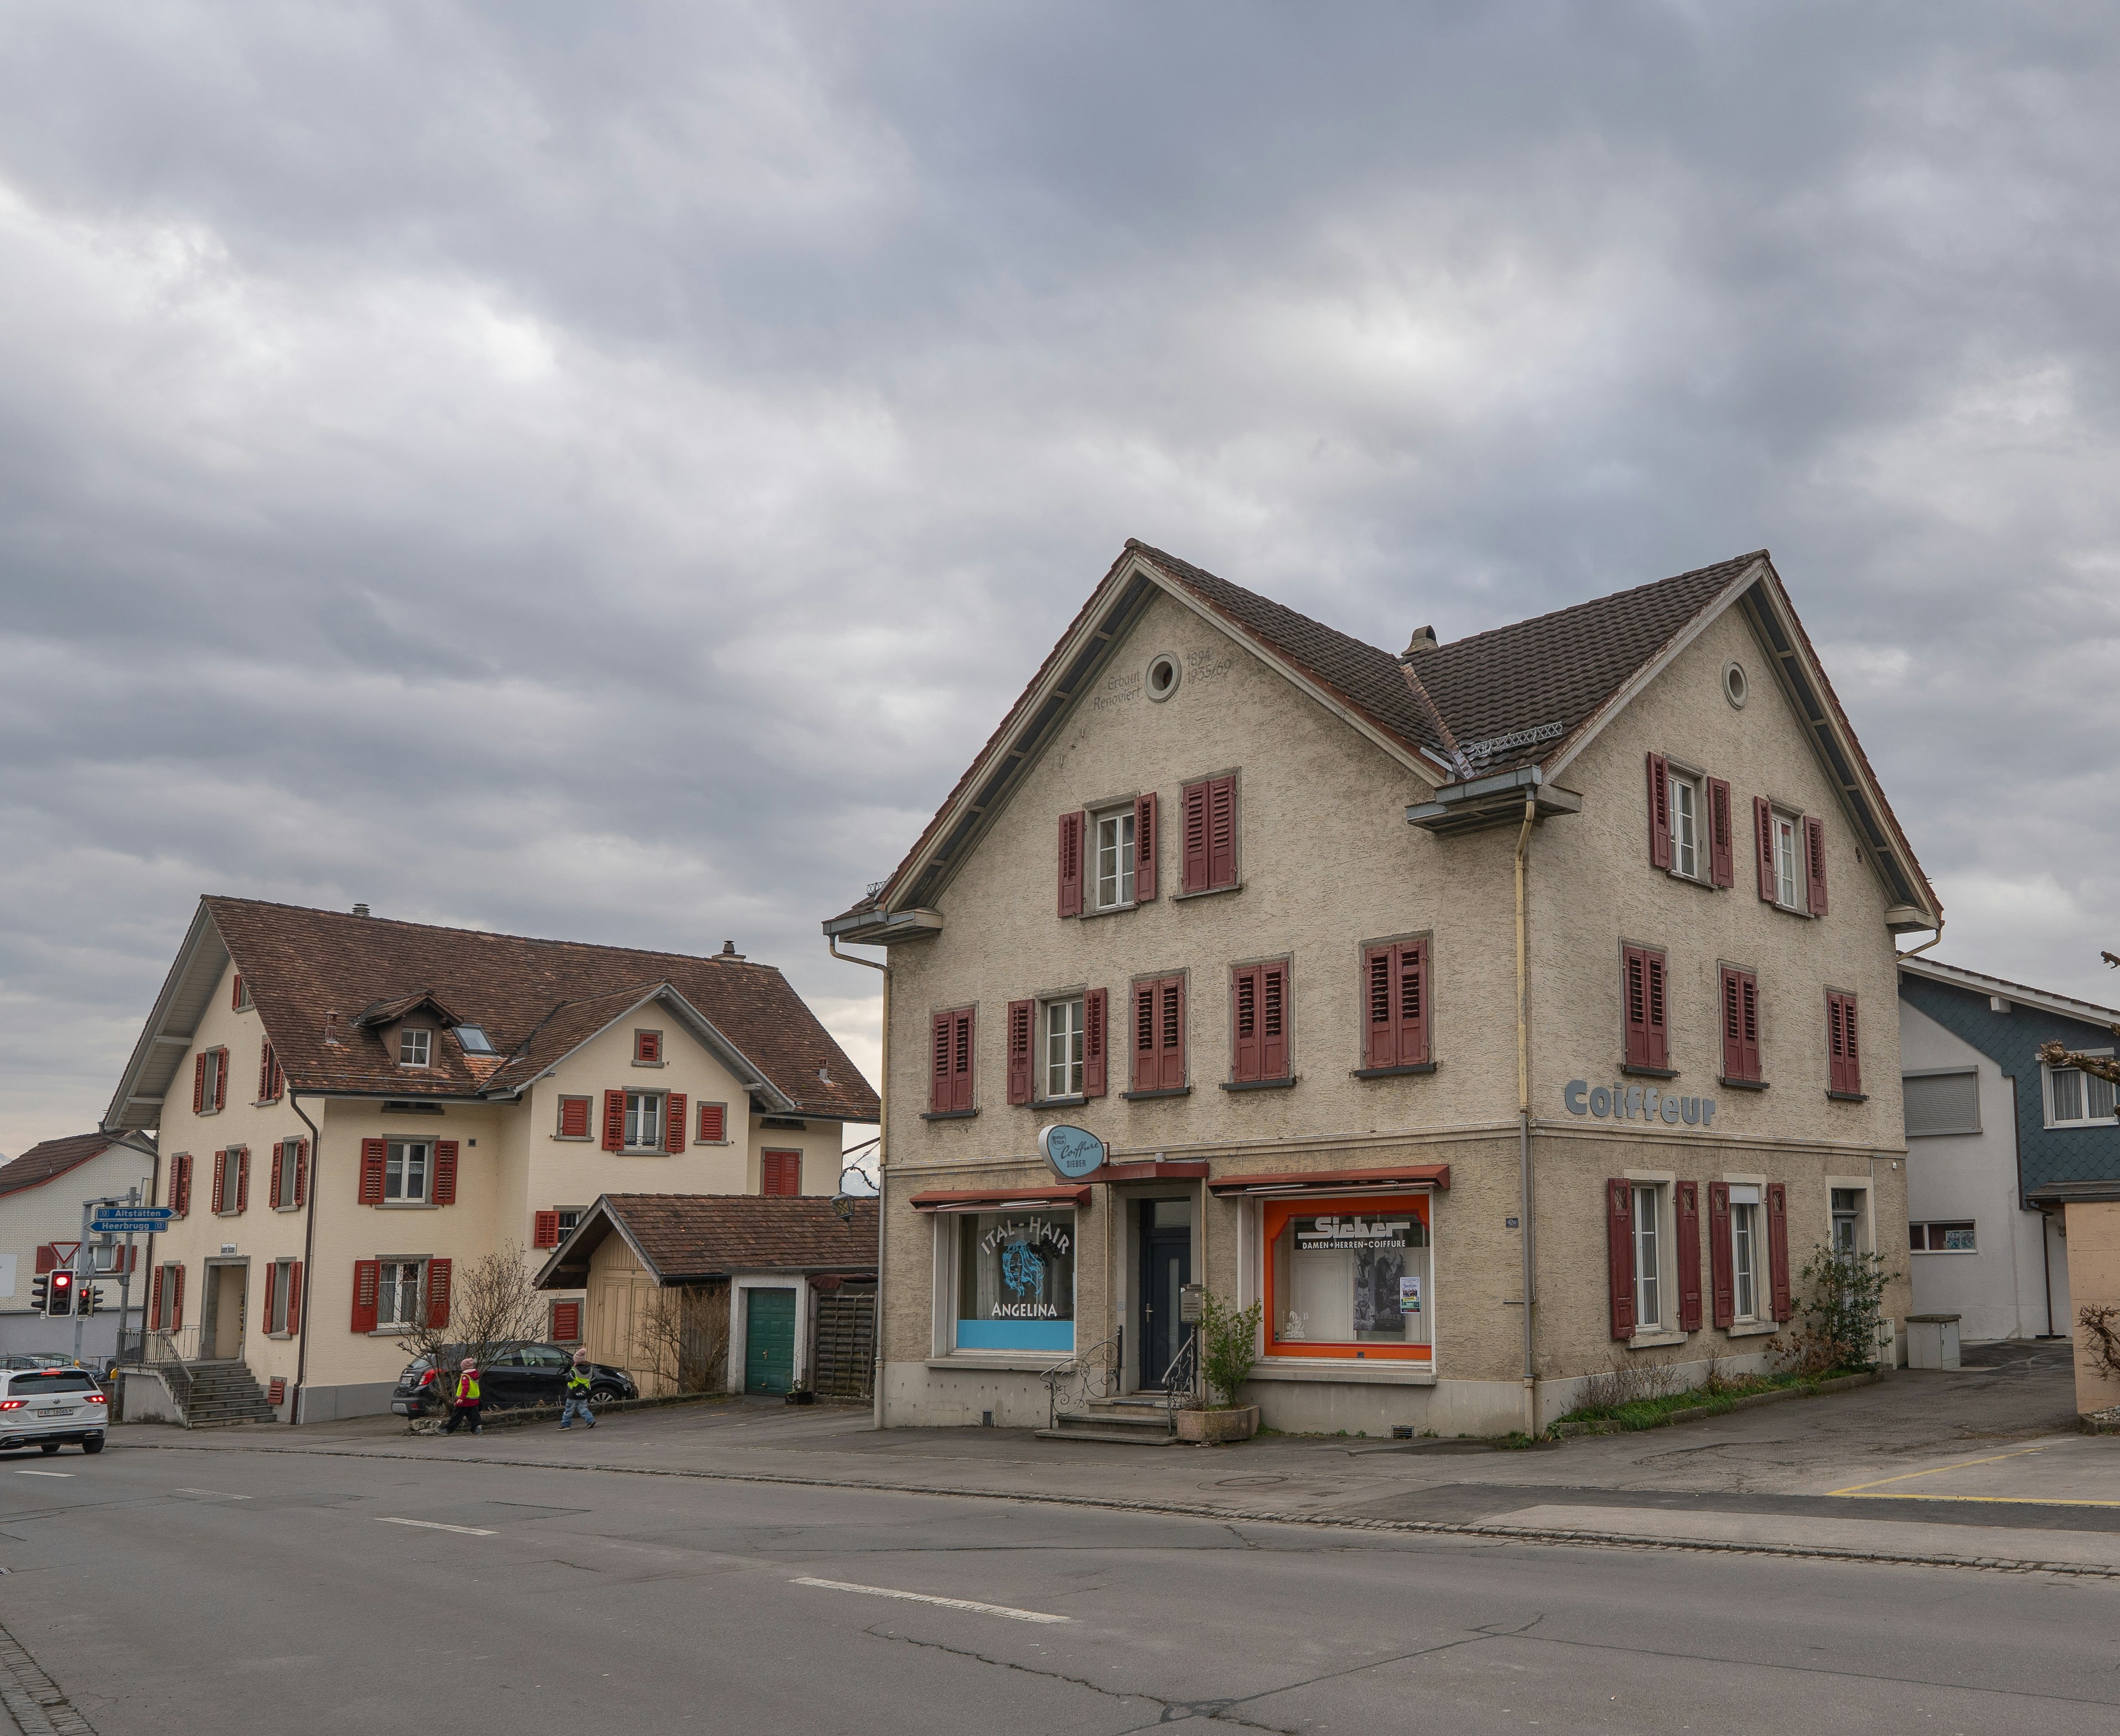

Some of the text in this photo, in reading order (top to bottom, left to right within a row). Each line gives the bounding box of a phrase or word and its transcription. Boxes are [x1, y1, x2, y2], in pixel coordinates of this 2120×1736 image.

[1107, 669, 1142, 690] Erbaut
[1093, 687, 1142, 711] Renoviert
[1564, 1079, 1716, 1125] Coiffeur
[1060, 1141, 1100, 1159] Coiffure
[1298, 1217, 1410, 1239] Sieber
[991, 1302, 1058, 1317] ANGELINA
